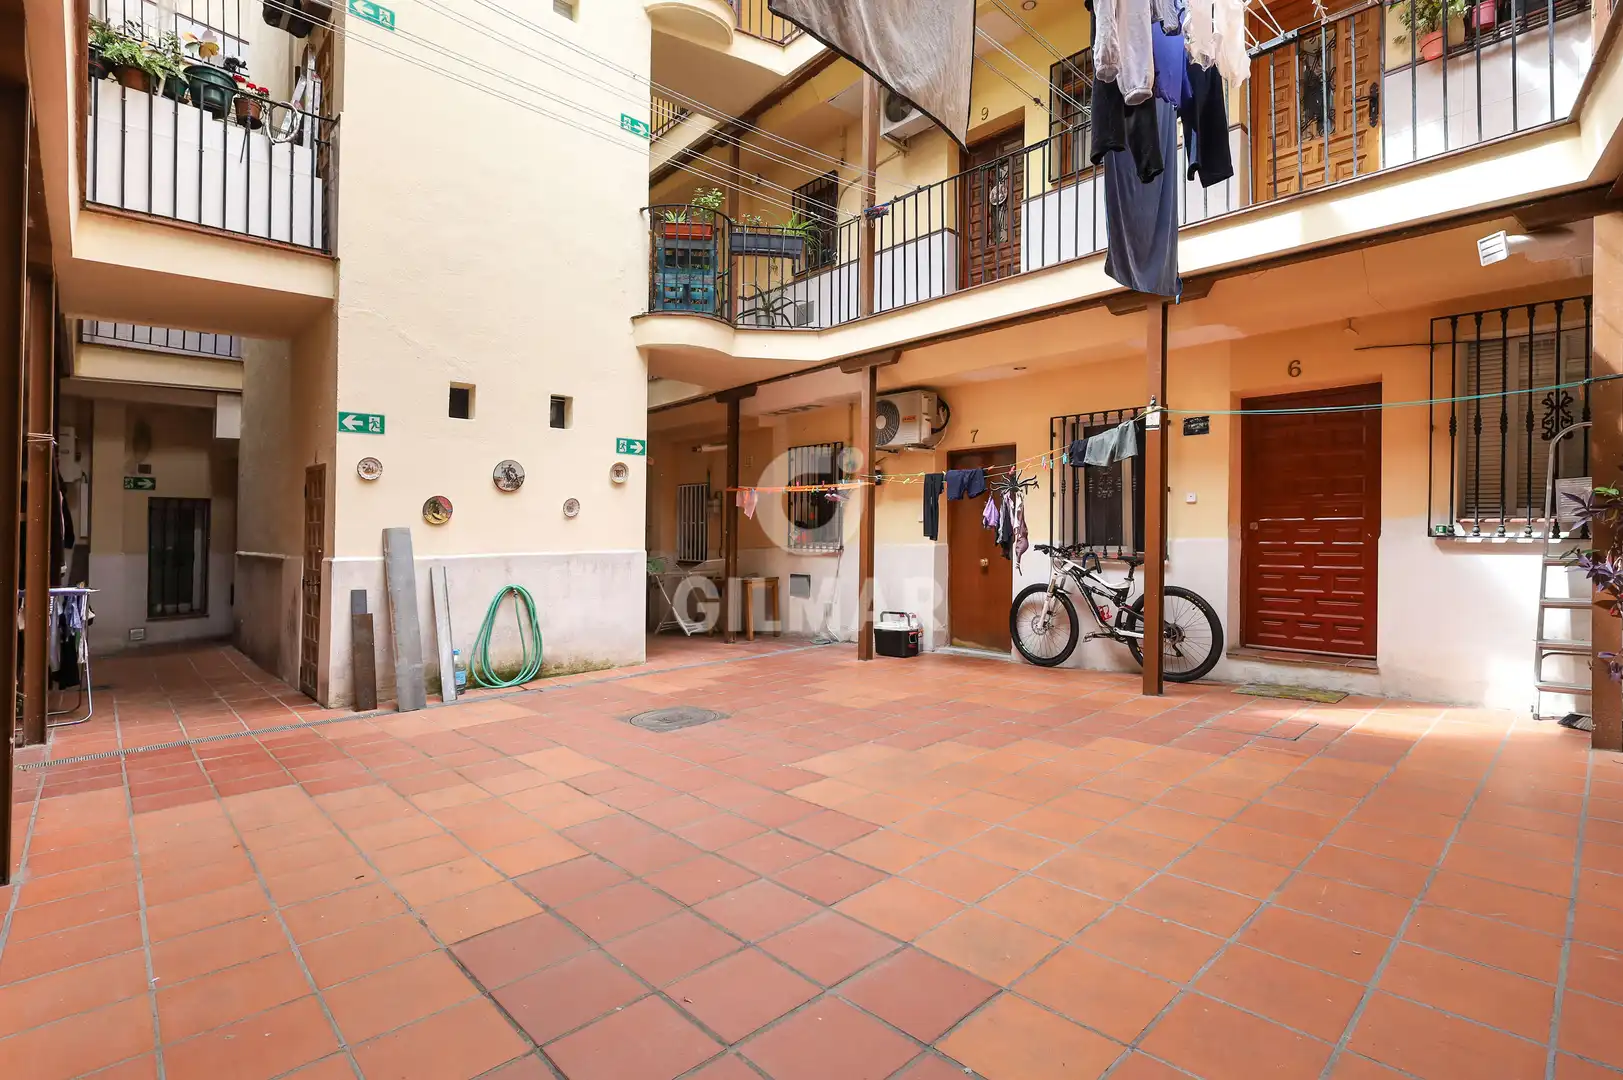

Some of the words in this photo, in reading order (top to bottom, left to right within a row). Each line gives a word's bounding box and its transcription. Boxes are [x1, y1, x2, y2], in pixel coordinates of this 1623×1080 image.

[981, 106, 989, 121] 9
[1288, 360, 1302, 378] 6
[970, 429, 979, 444] 7
